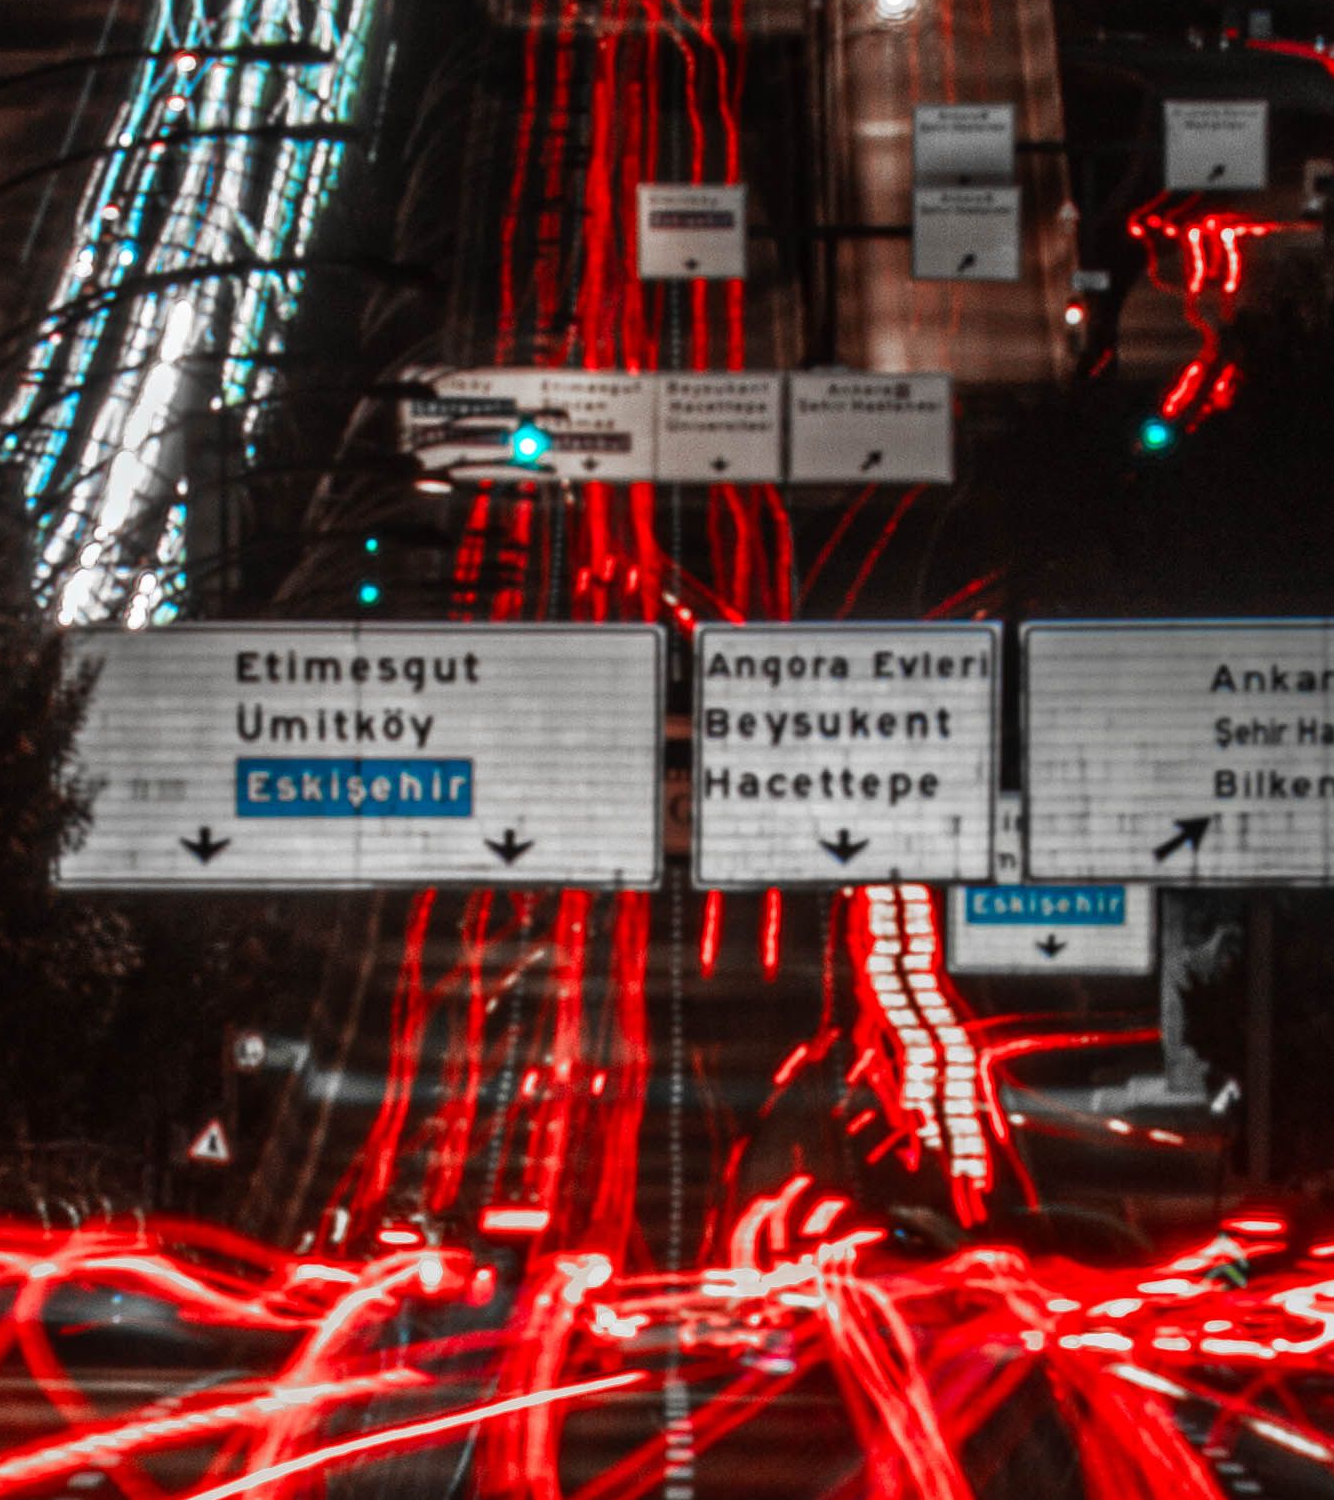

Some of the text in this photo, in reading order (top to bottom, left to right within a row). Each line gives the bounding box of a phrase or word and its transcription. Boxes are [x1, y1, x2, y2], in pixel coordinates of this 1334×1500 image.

[236, 651, 480, 693] Etimesgut
[706, 650, 989, 687] Angora Evleri
[703, 707, 951, 747] Beysukent
[1214, 715, 1289, 749] Şehir
[247, 767, 466, 808] Eskişehir
[703, 767, 940, 807] Hacettepe
[972, 890, 1123, 916] Eskişehir
